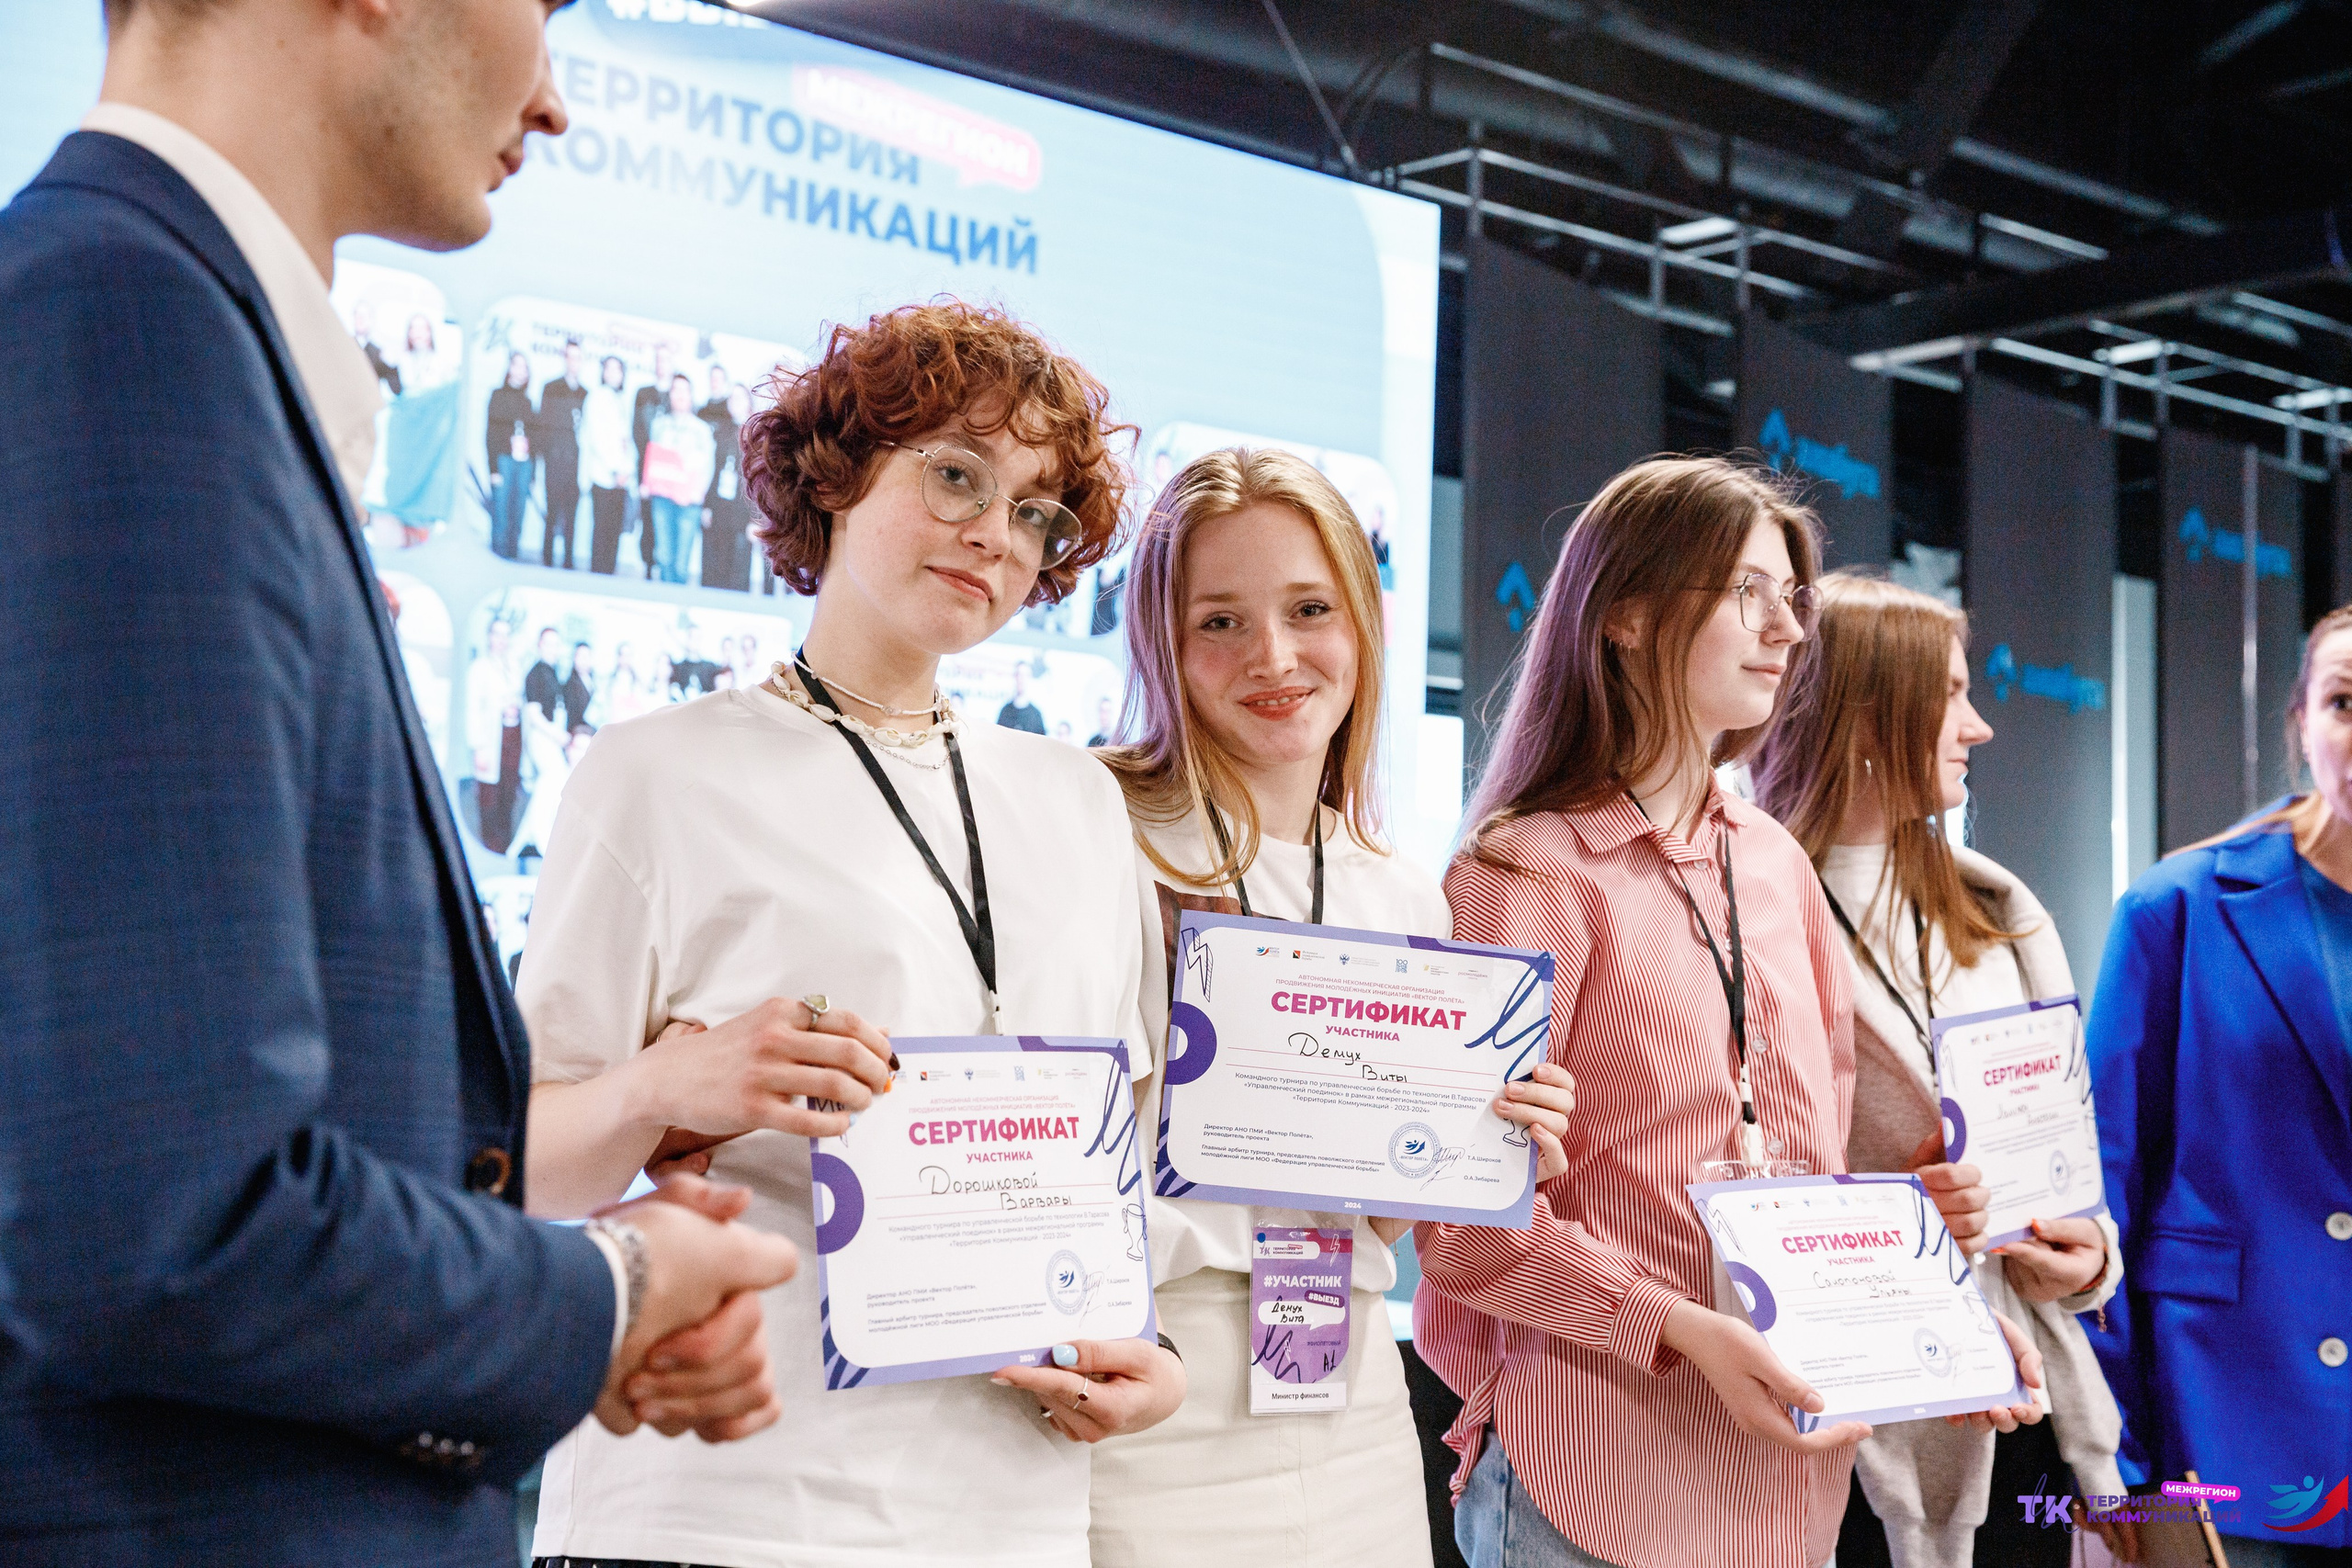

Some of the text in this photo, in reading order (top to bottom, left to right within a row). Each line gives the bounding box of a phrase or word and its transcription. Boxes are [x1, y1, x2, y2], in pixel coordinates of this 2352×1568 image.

[550, 51, 919, 186] ЕРРИТОРИЯ
[1275, 978, 1325, 988] ПРОДВИЖЕНИЯ
[1325, 985, 1371, 993] МОЛОДЁЖНЫХ
[1372, 989, 1410, 998] ИНИЦИАТИВ
[1297, 975, 1444, 994] АВТОНОМНАЯ НЕКОММЕРЧЕСКАЯ ОРГАНИЗАЦИЯ
[1271, 991, 1467, 1031] СЕРТИФИКАТ
[1326, 1025, 1400, 1042] УЧАСТНИКА
[1288, 1032, 1361, 1066] Демух
[1363, 1064, 1408, 1083] Виты
[1984, 1055, 2062, 1087] СЕРТИФИКАТ
[1235, 1072, 1278, 1081] Командного
[1318, 1082, 1375, 1091] управленческой
[1376, 1086, 1401, 1094] борьбе
[1412, 1090, 1450, 1099] технологии
[1451, 1094, 1486, 1102] В.Тарасова
[1338, 1099, 1389, 1109] Коммуникаций
[1375, 1096, 1438, 1105] межрегиональной
[1439, 1101, 1476, 1110] программы
[909, 1117, 1080, 1146] СЕРТИФИКАТ
[1203, 1123, 1233, 1132] Директор
[967, 1151, 1033, 1163] УЧАСТНИКА
[1467, 1155, 1501, 1163] Т.А.Широков
[919, 1165, 1038, 1195] Дорошковой
[1464, 1175, 1500, 1183] О.А.Зибарева
[1001, 1192, 1071, 1211] Варвары
[1781, 1230, 1904, 1254] СЕРТИФИКАТ
[1826, 1256, 1875, 1266] УЧАСТНИКА
[1263, 1275, 1342, 1288] #УЧАСТНИК
[1308, 1292, 1340, 1306] #ВЫЕЗД
[1281, 1314, 1304, 1324] Вита
[1272, 1393, 1299, 1401] Министр
